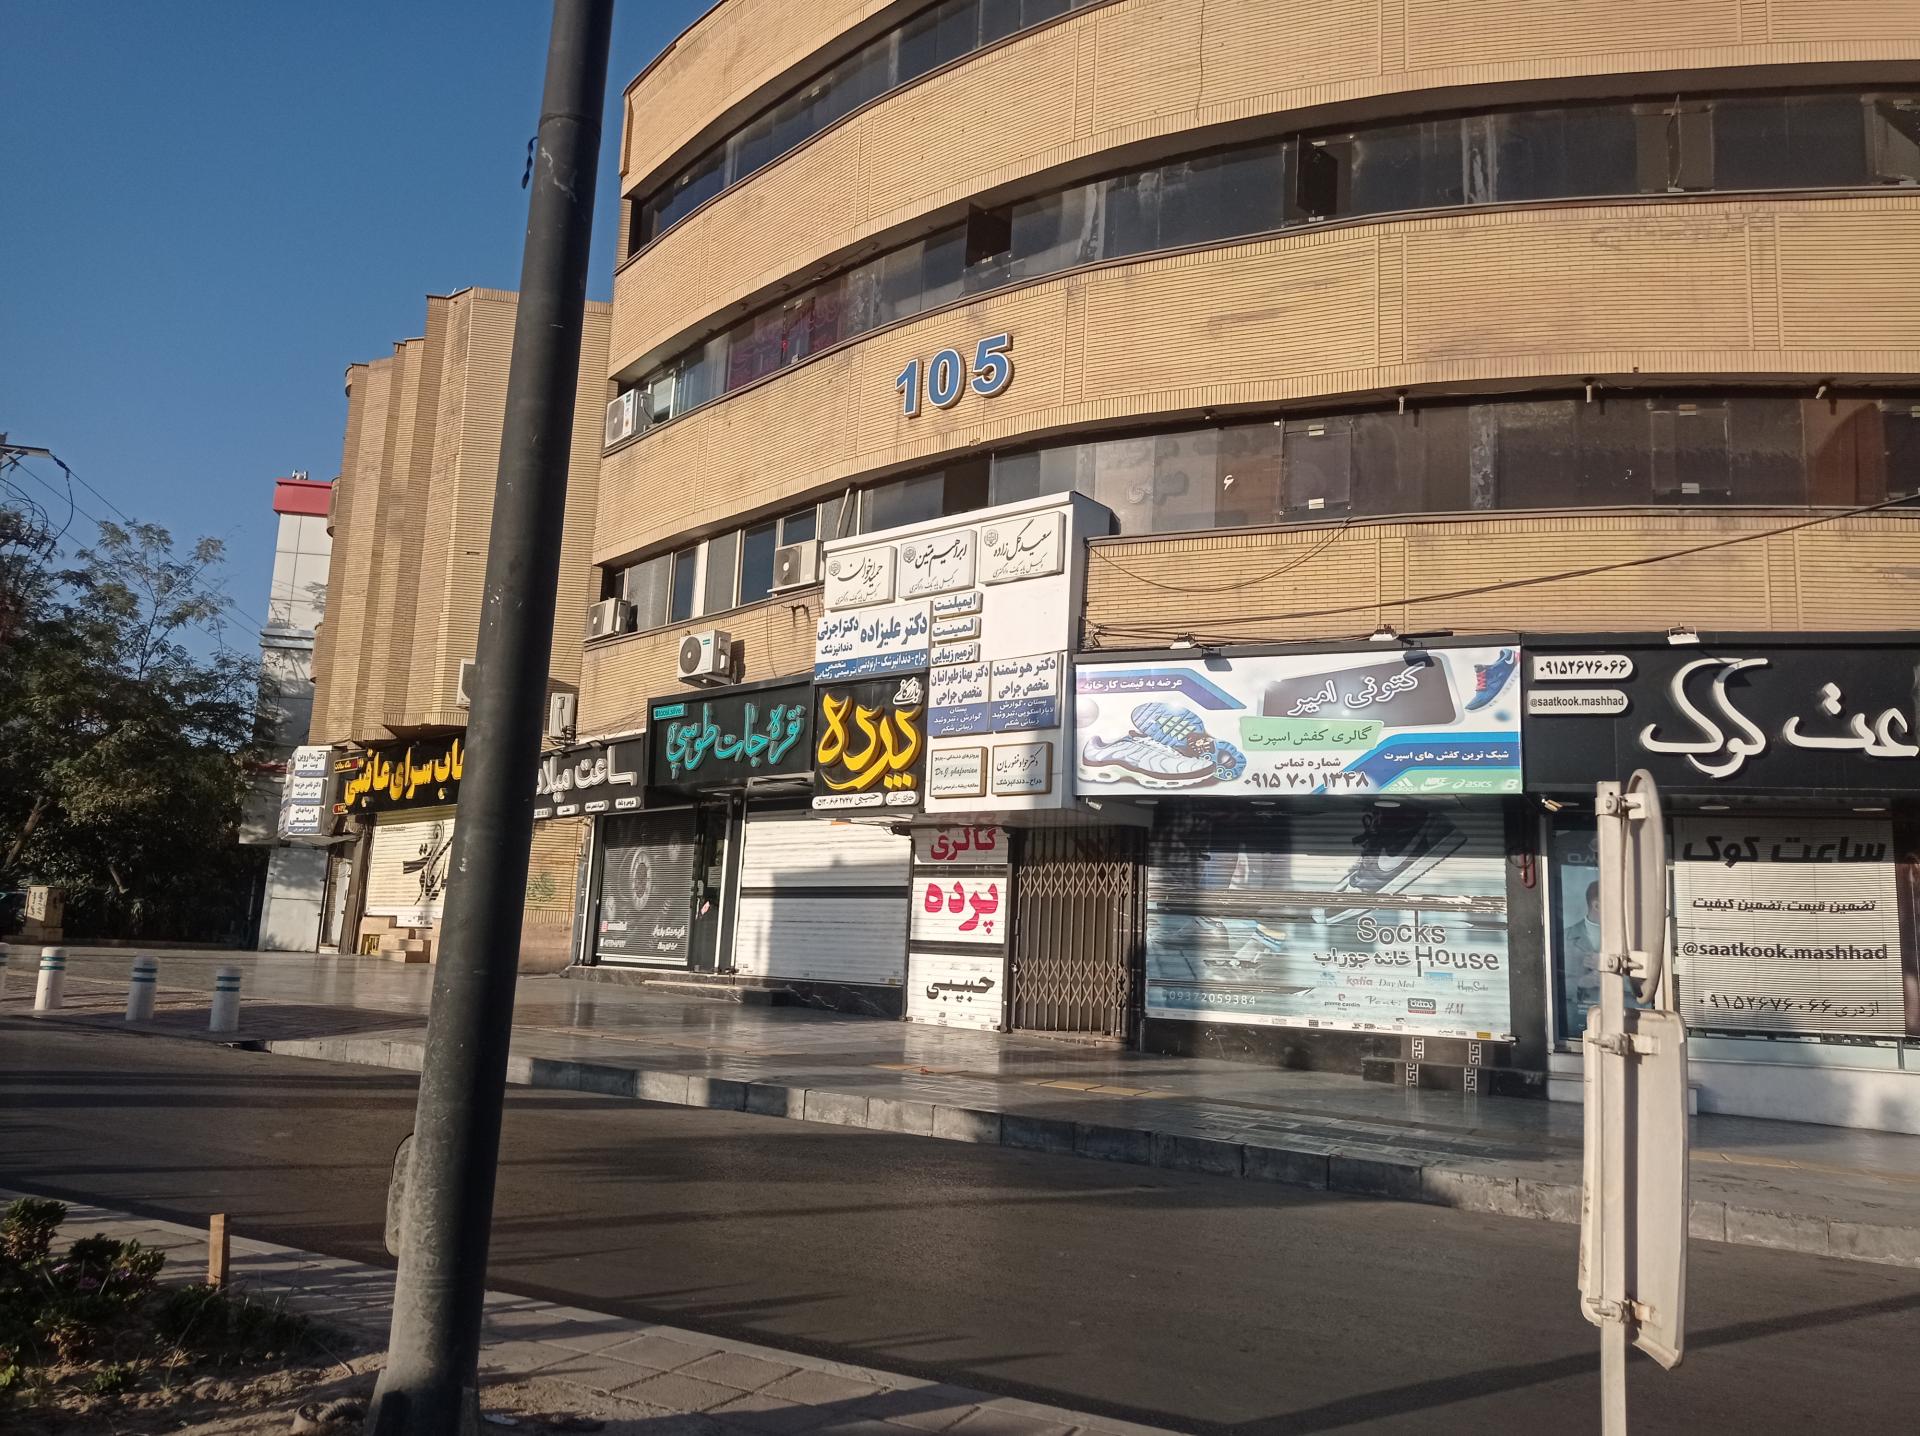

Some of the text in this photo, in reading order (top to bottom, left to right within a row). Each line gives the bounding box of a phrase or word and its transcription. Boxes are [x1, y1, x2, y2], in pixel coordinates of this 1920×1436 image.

[895, 332, 1014, 419] 105
[929, 539, 968, 577] ابراهیم
[934, 593, 976, 612] ایمپلنت
[840, 616, 859, 638] دکتر
[860, 612, 928, 648] دکتر علیزاده
[933, 618, 974, 636] لمینت
[821, 642, 853, 656] دندانپزشک
[931, 645, 974, 664] ترمیم زیبایی
[975, 664, 989, 681] دکتر
[993, 657, 1057, 678] دکتر هوشمند
[1540, 660, 1627, 675] ۰۹۱۵۲۶۷۶۰۶۶
[998, 678, 1050, 699] متخصص جراحی
[1119, 678, 1144, 690] قیمت
[1145, 680, 1156, 690] به
[1157, 678, 1183, 689] عرضه
[1287, 661, 1427, 715] کتونی امیر
[936, 686, 983, 706] متخصص جراحی
[1530, 696, 1624, 707] @saatkook.mashhad
[1640, 657, 1769, 779] کوک
[666, 702, 720, 780] طوسی
[818, 693, 923, 792] پرده
[1248, 726, 1373, 746] گالری کفش اسپرت
[1274, 757, 1341, 769] شماره تماس
[1384, 750, 1509, 762] شیک ترین کفش های اسپرت
[575, 745, 637, 789] ساعت
[1244, 771, 1369, 788] ۰۹۱۵ ۷۰۱ ۱۳۴۸
[854, 794, 879, 806] حبیبی
[1682, 835, 1887, 868] ساعت کوک
[924, 881, 999, 934] پرده
[1692, 897, 1734, 911] کیفیت
[1737, 899, 1782, 913] تضمین
[1828, 900, 1877, 914] تضمین
[1356, 911, 1447, 945] Socks
[1313, 948, 1411, 968] خانه جوراب
[1415, 945, 1500, 974] House
[1682, 942, 1888, 960] @saatkook.mashhad
[926, 976, 996, 1003] حبیبی
[1169, 989, 1257, 1006] 09372059384
